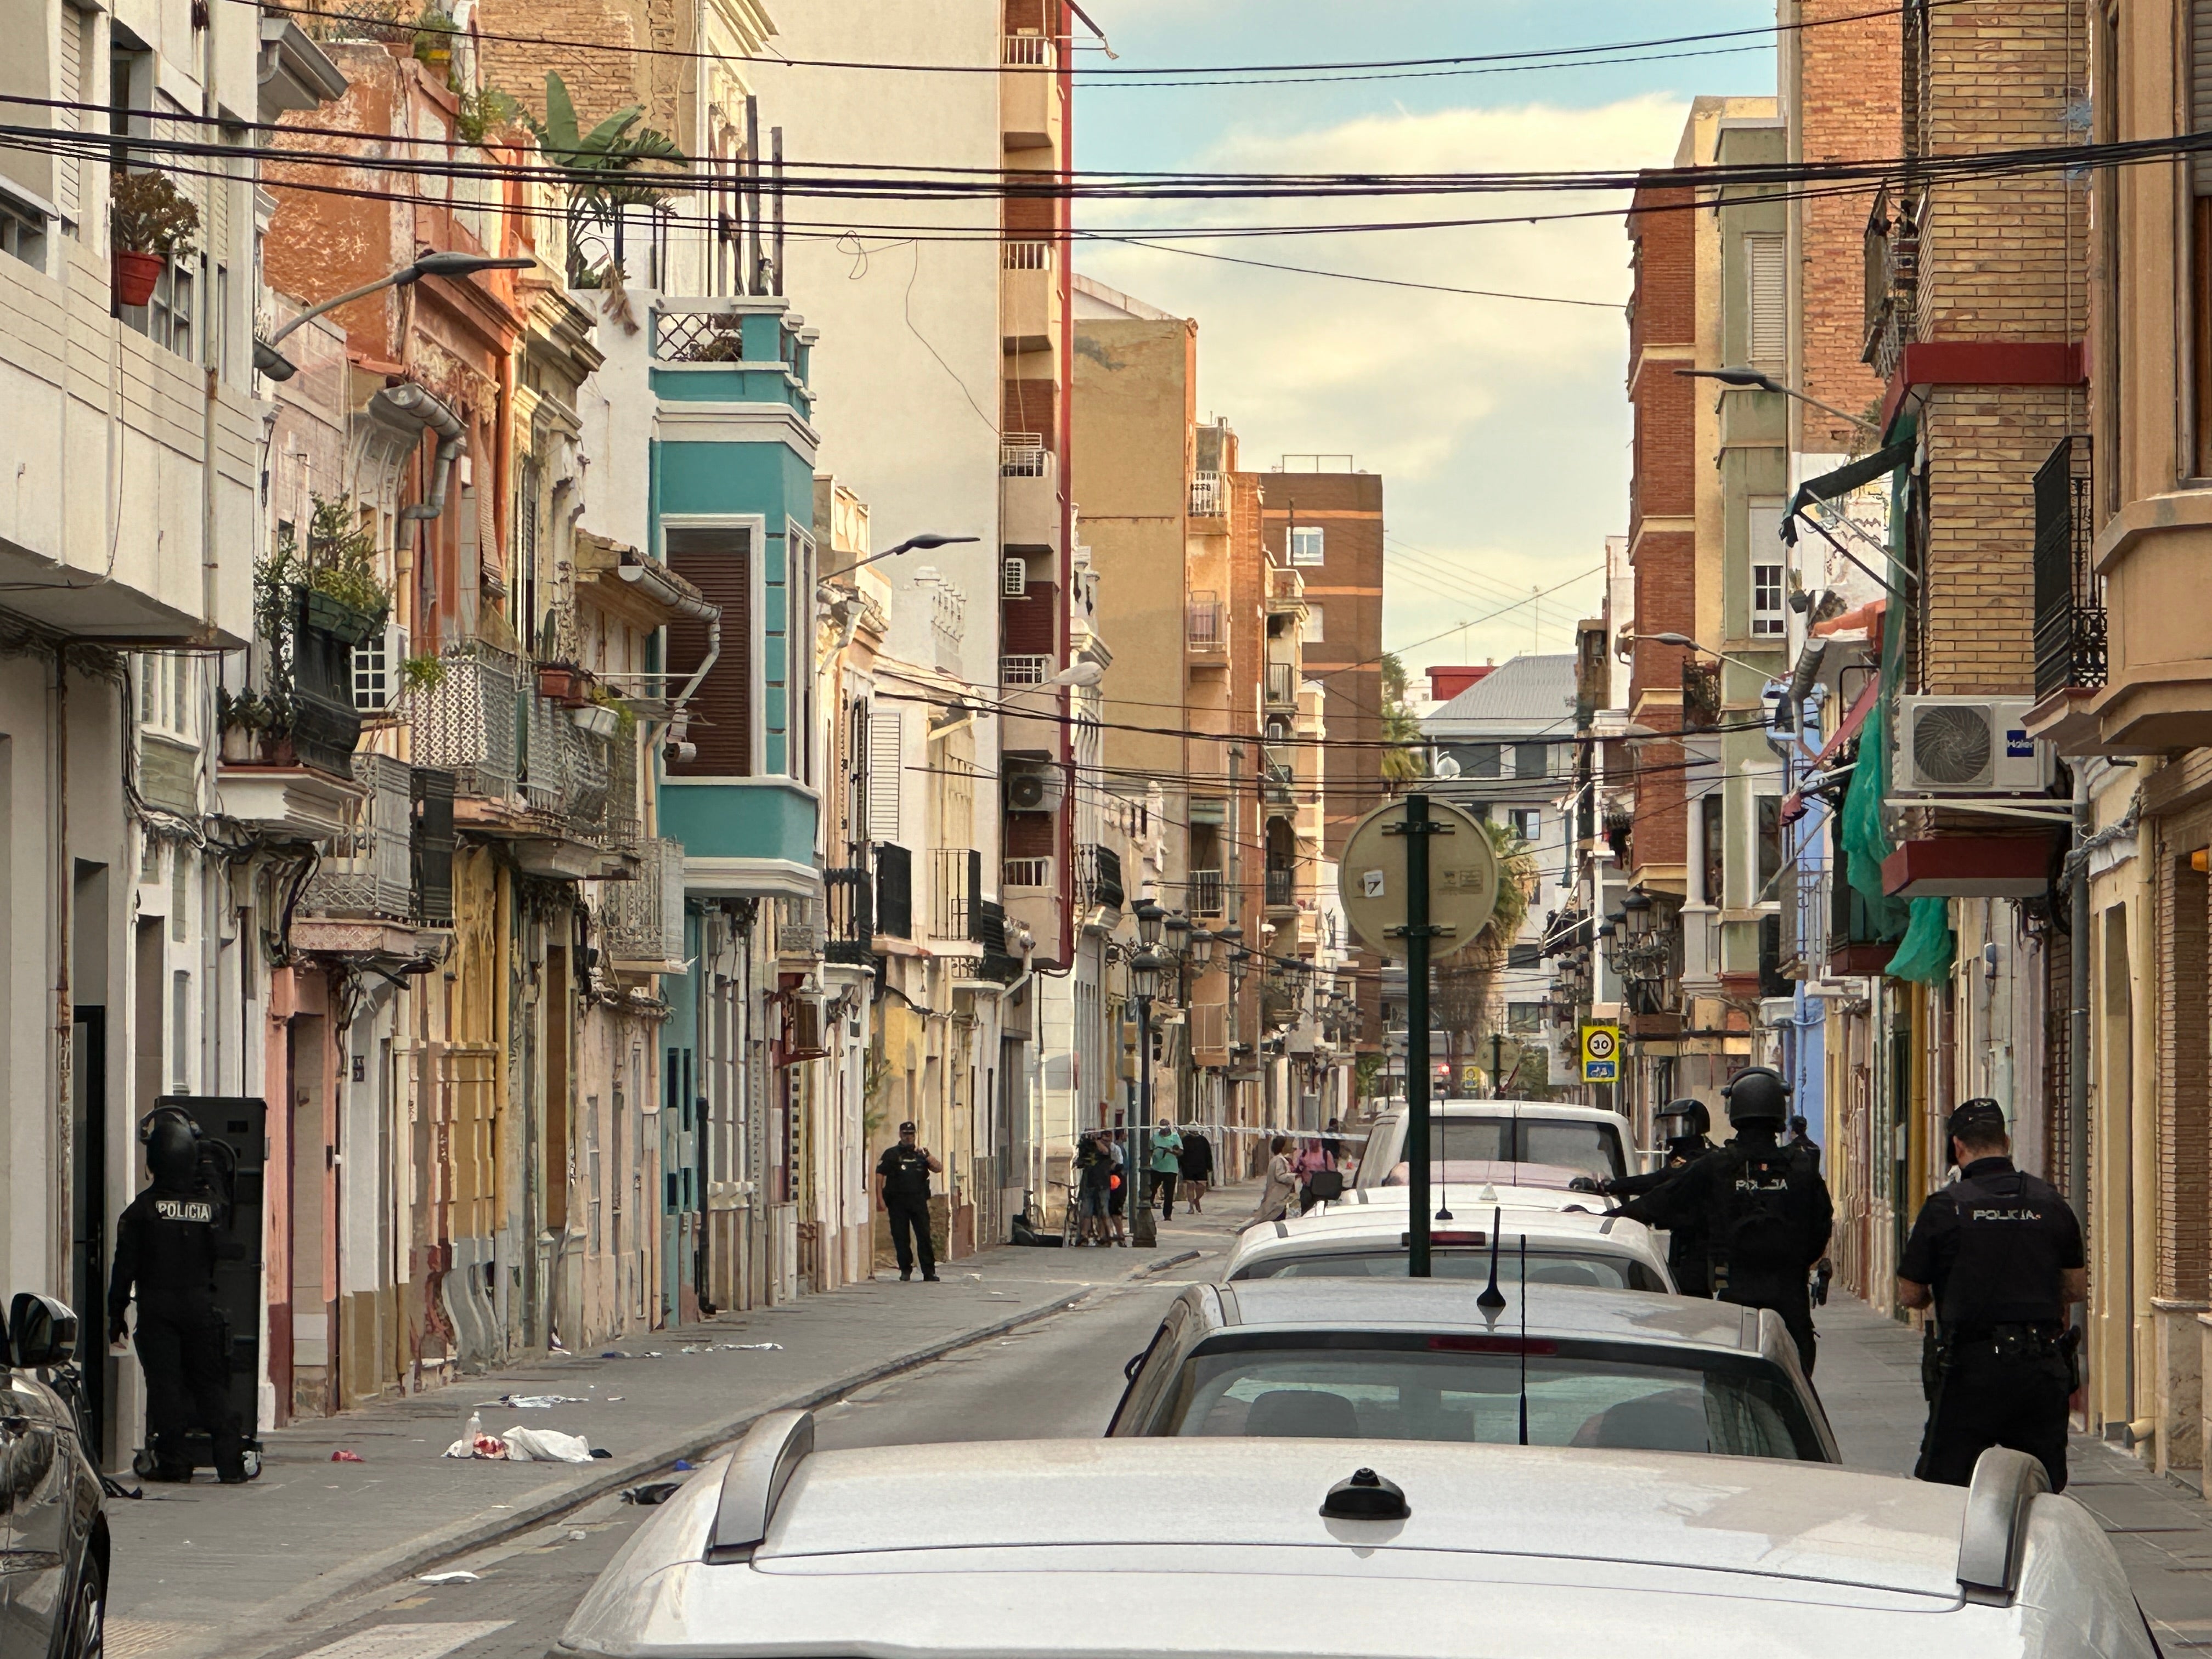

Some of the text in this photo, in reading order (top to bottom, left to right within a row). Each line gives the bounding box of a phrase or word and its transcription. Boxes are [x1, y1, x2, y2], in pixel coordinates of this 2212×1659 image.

[1593, 1040, 1609, 1049] 30
[1735, 1178, 1788, 1191] POIA
[157, 1202, 210, 1220] POLICIA
[1973, 1209, 2038, 1221] POLICIA
